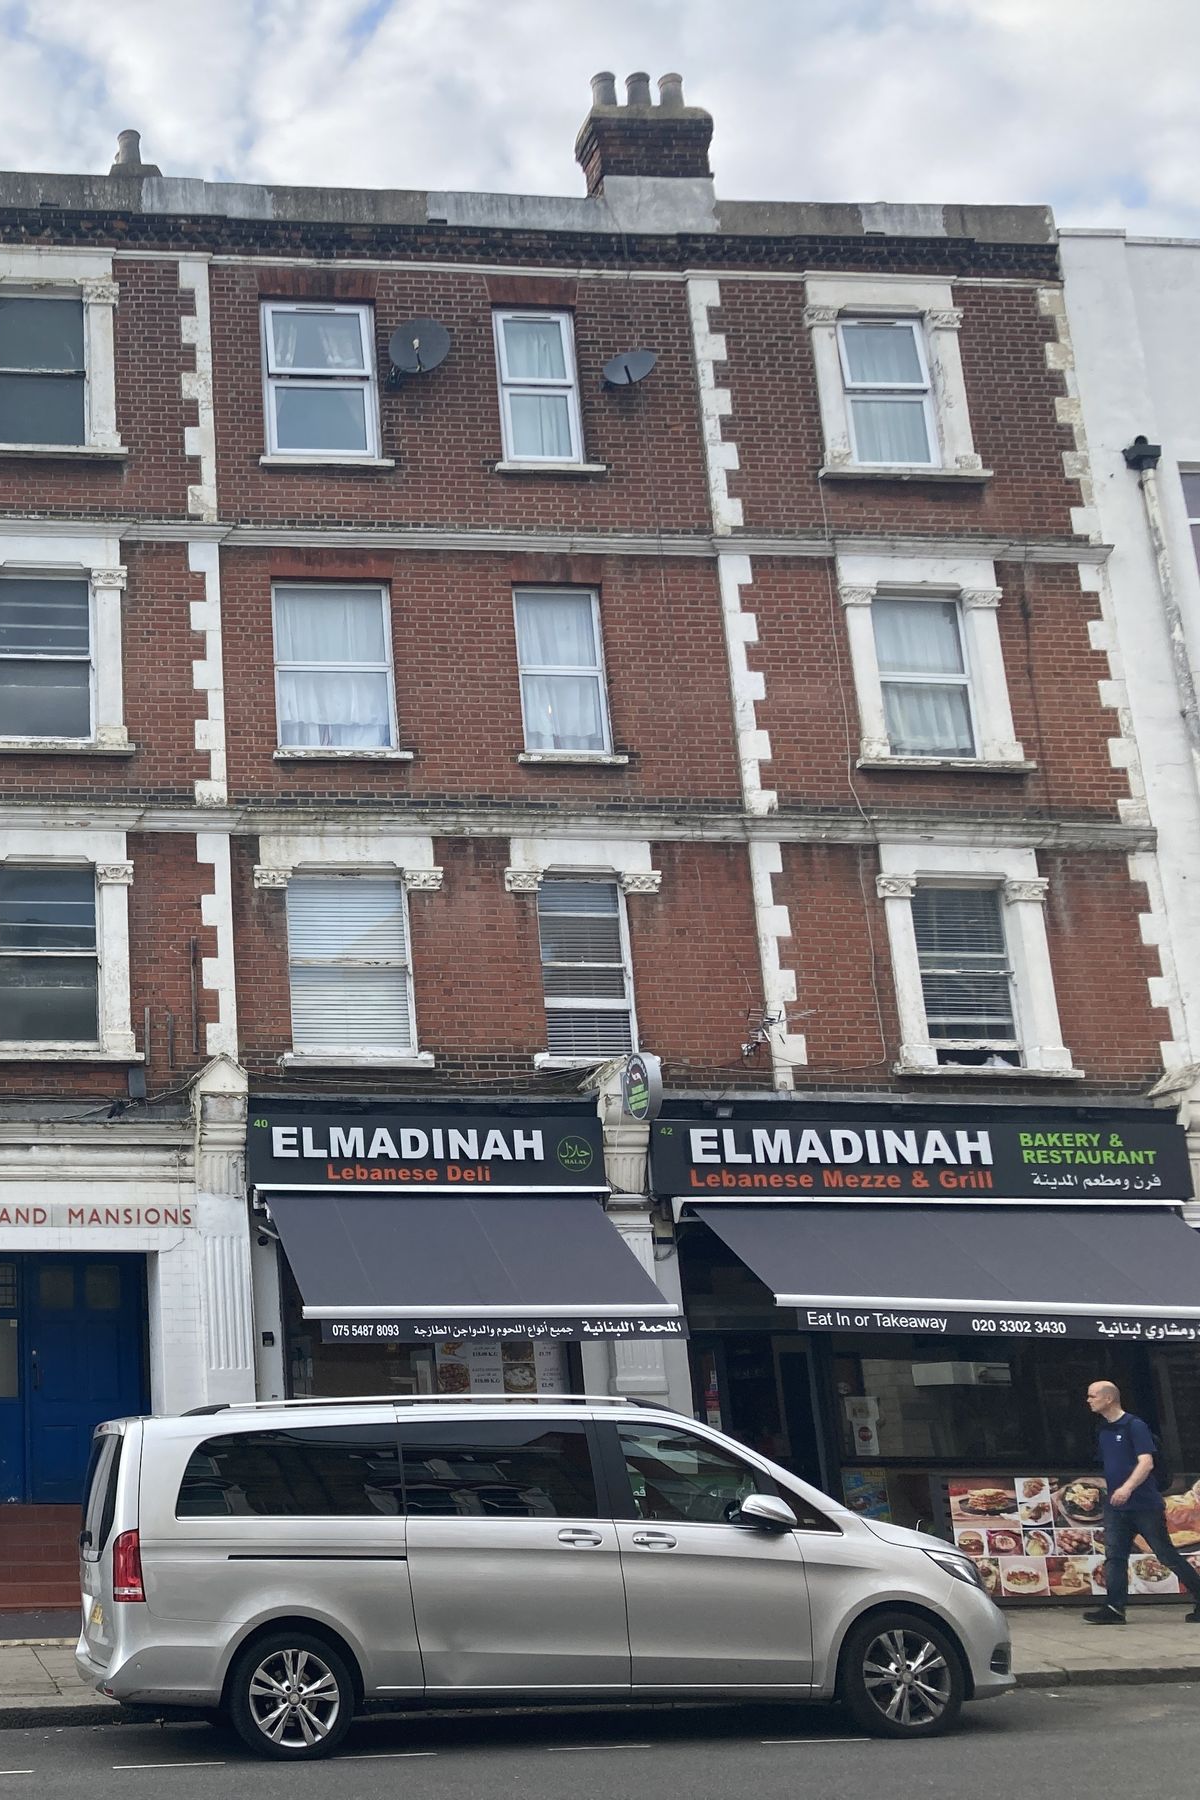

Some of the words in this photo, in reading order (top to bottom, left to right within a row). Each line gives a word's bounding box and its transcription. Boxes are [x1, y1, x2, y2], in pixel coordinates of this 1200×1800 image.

[253, 1119, 268, 1129] 40
[660, 1127, 673, 1136] 42
[271, 1126, 545, 1161] ELMADINAH
[689, 1128, 994, 1166] ELMADINAH
[1019, 1133, 1100, 1147] BAKERY
[1109, 1133, 1124, 1148] &
[1022, 1150, 1157, 1165] RESTAURANT
[327, 1164, 438, 1181] Lebanese
[447, 1164, 491, 1182] Deli
[690, 1168, 814, 1188] Lebanese
[822, 1170, 901, 1188] Mezze
[911, 1170, 929, 1187] &
[939, 1170, 993, 1188] Grill
[1031, 1173, 1078, 1190] المدينة
[1134, 1174, 1162, 1190] فرن
[68, 1207, 192, 1225] MANSIONS
[332, 1324, 350, 1337] 075
[351, 1324, 374, 1337] 5487
[376, 1324, 399, 1337] 8093
[496, 1324, 526, 1337] اللحوم
[527, 1321, 548, 1338] أنواع
[582, 1320, 635, 1337] اللبنانية
[637, 1320, 682, 1333] الملحمة
[807, 1311, 833, 1326] Eat
[836, 1312, 850, 1326] In
[854, 1315, 870, 1327] or
[872, 1313, 947, 1332] Takeaway
[972, 1319, 996, 1332] 020
[1000, 1320, 1031, 1333] 3302
[1035, 1321, 1067, 1334] 3430
[1096, 1321, 1142, 1339] لبنانية
[414, 1325, 451, 1338] الطازجة
[550, 1326, 574, 1338] جميع
